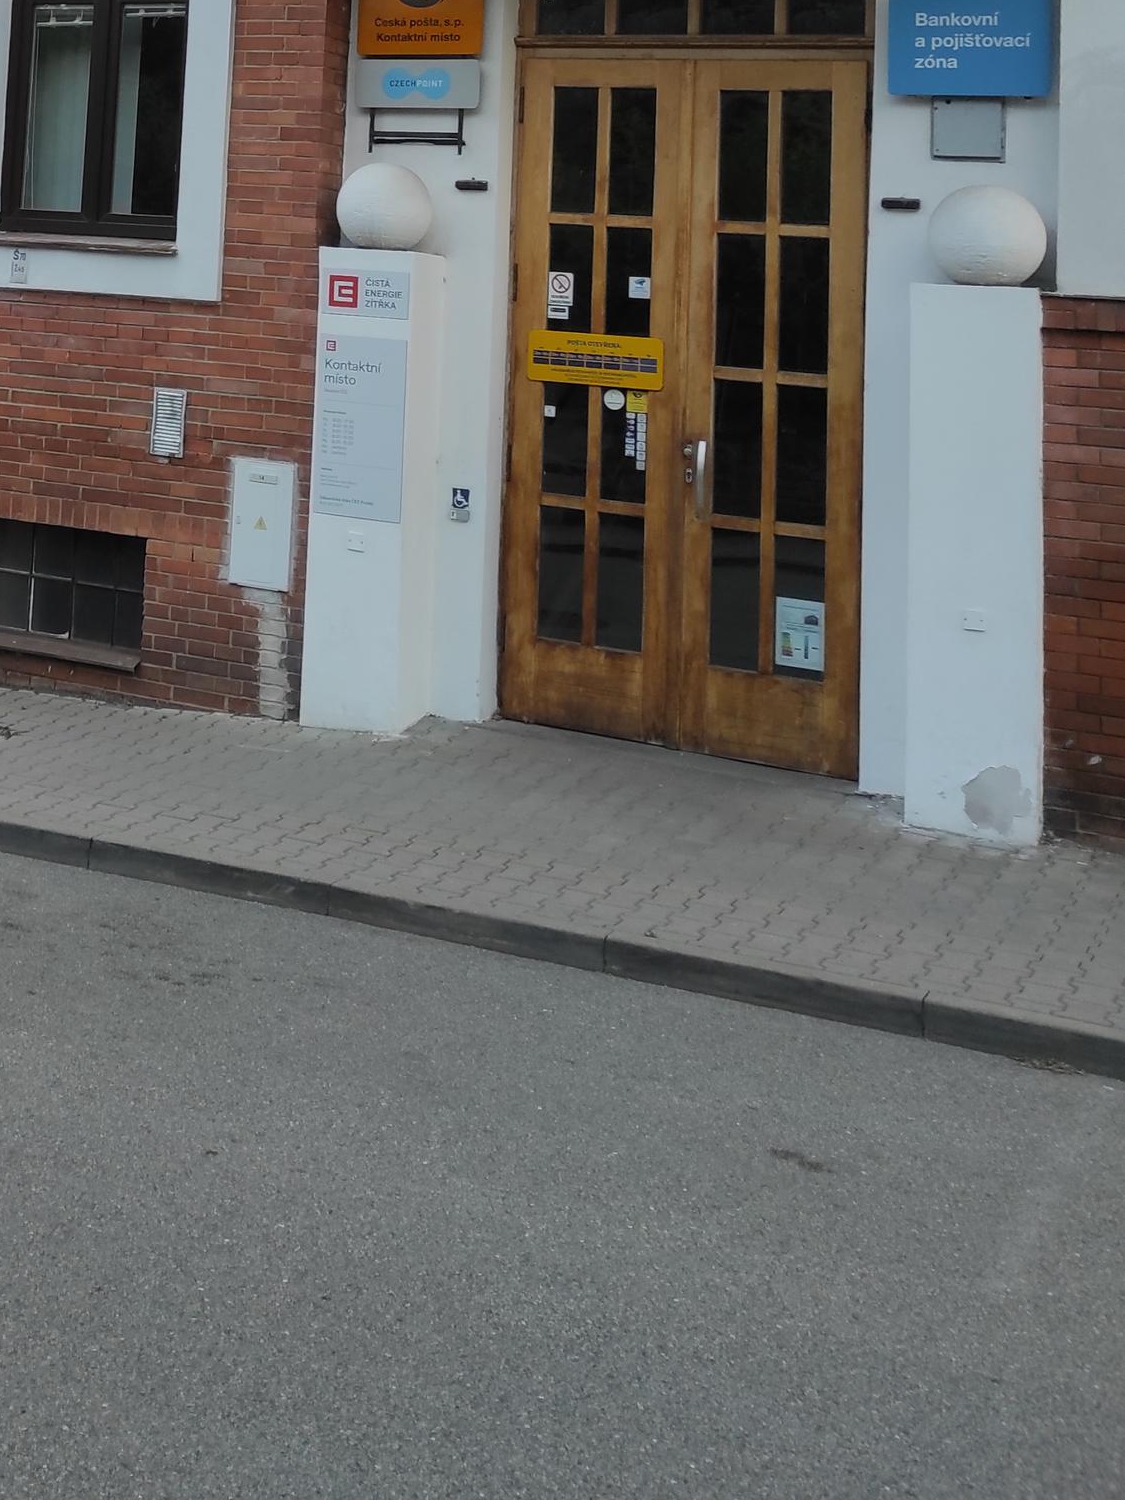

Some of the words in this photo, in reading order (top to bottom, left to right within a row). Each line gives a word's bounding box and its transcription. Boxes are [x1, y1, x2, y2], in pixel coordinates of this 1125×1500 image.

[374, 17, 406, 27] Česká
[444, 18, 465, 28] s.p.
[915, 11, 1000, 27] Bankovní
[376, 32, 427, 42] Kontaktní
[430, 32, 461, 42] místo
[914, 36, 926, 48] a
[931, 32, 1032, 51] pojišťovací
[914, 54, 958, 69] zóna
[365, 277, 392, 288] ČISTÁ
[364, 289, 403, 299] ENERGIE
[364, 299, 397, 310] ZÍTŘKA
[325, 358, 383, 373] Kontaktní
[324, 373, 357, 386] místo
